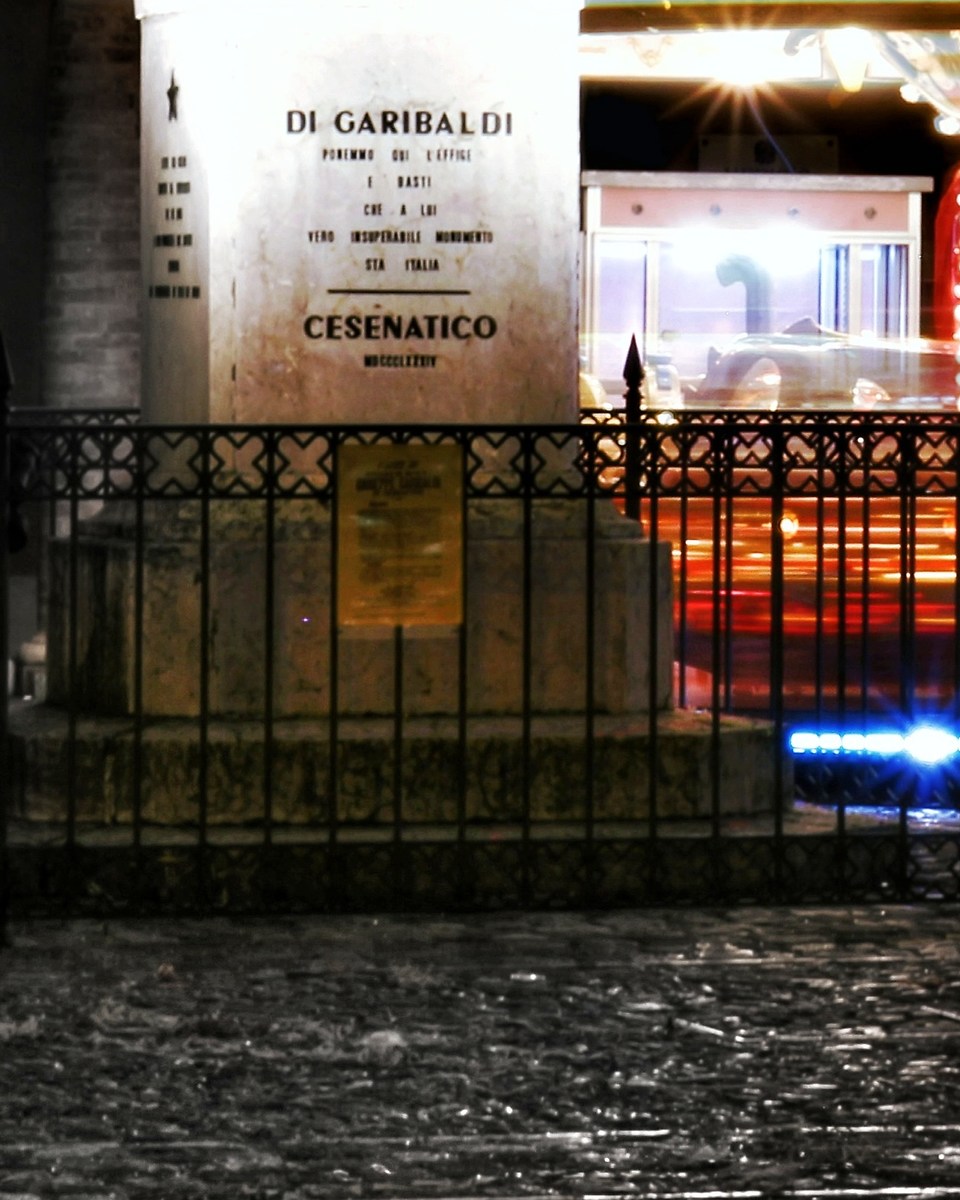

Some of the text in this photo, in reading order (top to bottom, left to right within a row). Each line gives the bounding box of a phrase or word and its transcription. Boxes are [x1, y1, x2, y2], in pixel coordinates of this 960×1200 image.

[286, 110, 513, 136] DI GARIBALDI
[367, 175, 433, 189] E BASTI
[363, 203, 438, 217] CHE A LUI
[307, 230, 494, 244] VERO INSUPERABILE MONUMENTO
[365, 257, 440, 272] STA ITALIA
[303, 314, 498, 340] CESENATICO
